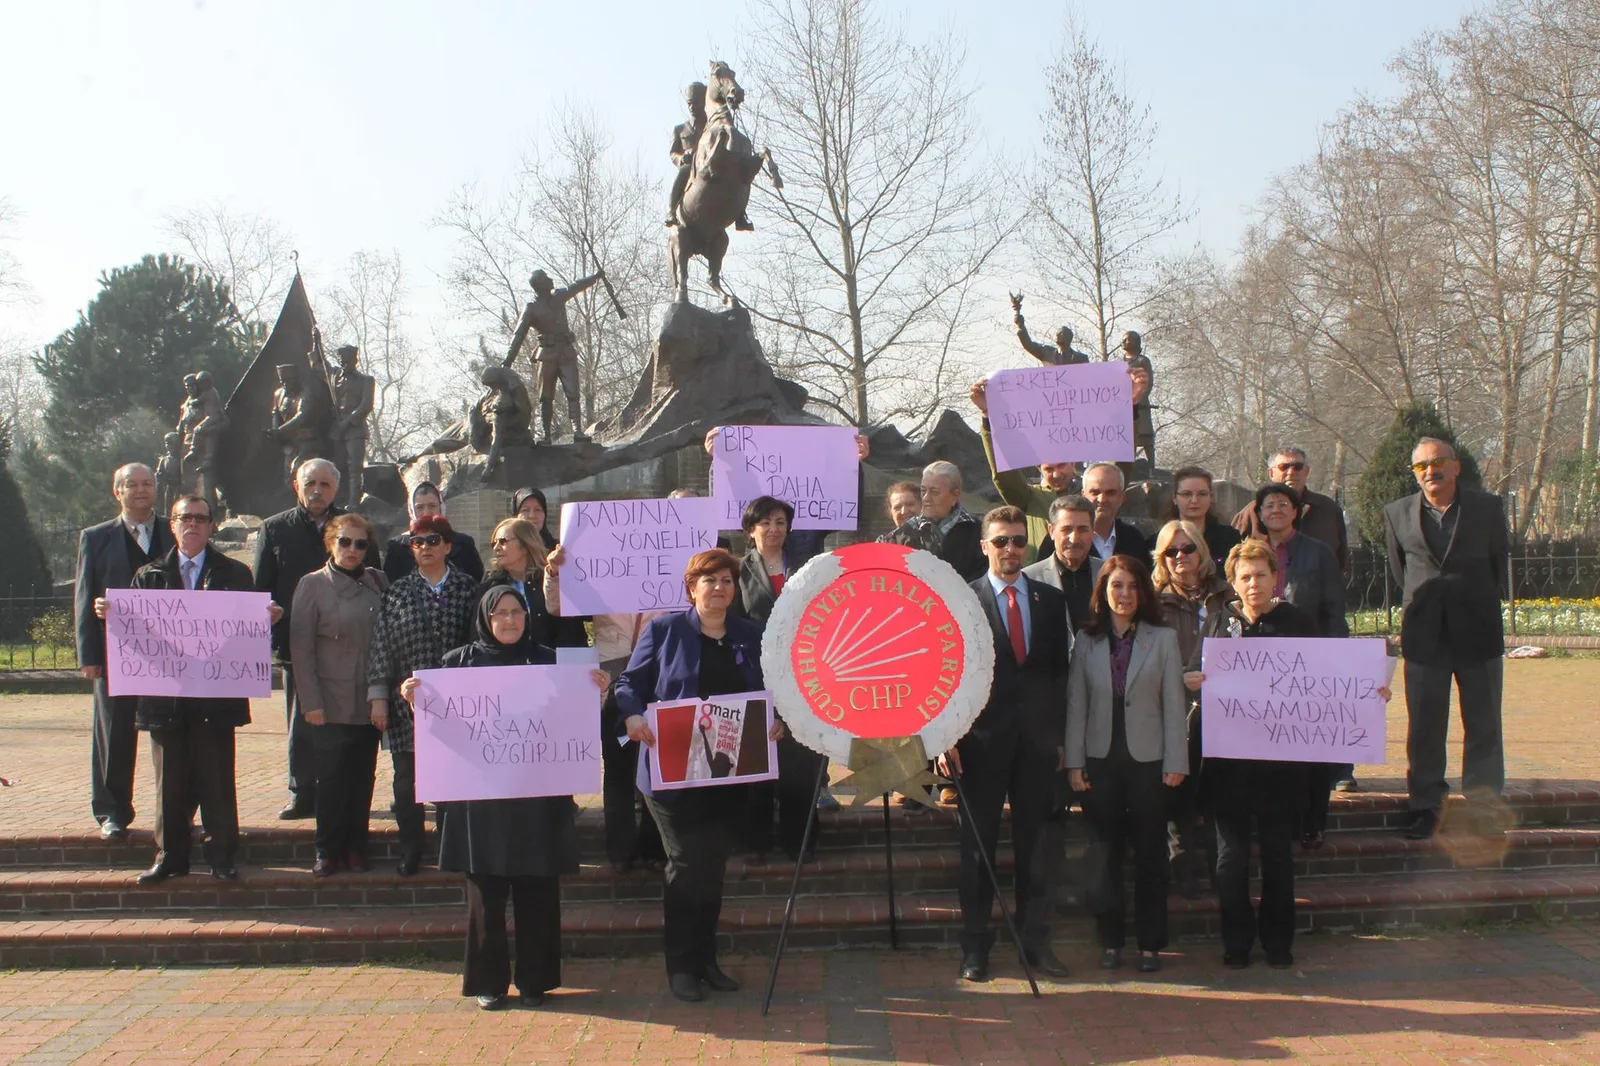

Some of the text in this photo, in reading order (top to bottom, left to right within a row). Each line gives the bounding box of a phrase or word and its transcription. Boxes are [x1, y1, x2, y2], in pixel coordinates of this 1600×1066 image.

[999, 370, 1071, 393] ERKEK
[1003, 407, 1075, 430] DEVLET
[1047, 424, 1133, 445] KORUYOR
[765, 474, 825, 498] DAHA
[576, 500, 683, 528] KADINA
[115, 594, 189, 615] DÜNYA
[870, 576, 939, 616] HALK
[221, 619, 270, 639] OYNAR
[118, 639, 223, 659] KADINLAR
[1215, 650, 1307, 676] SAVAŞA
[423, 694, 502, 720] KADIN
[849, 684, 912, 712] CHP
[1218, 698, 1357, 725] YAŞAMDAN
[1264, 723, 1371, 747] YANAYIZ
[482, 739, 598, 764] ÖZGÜRLÜK
